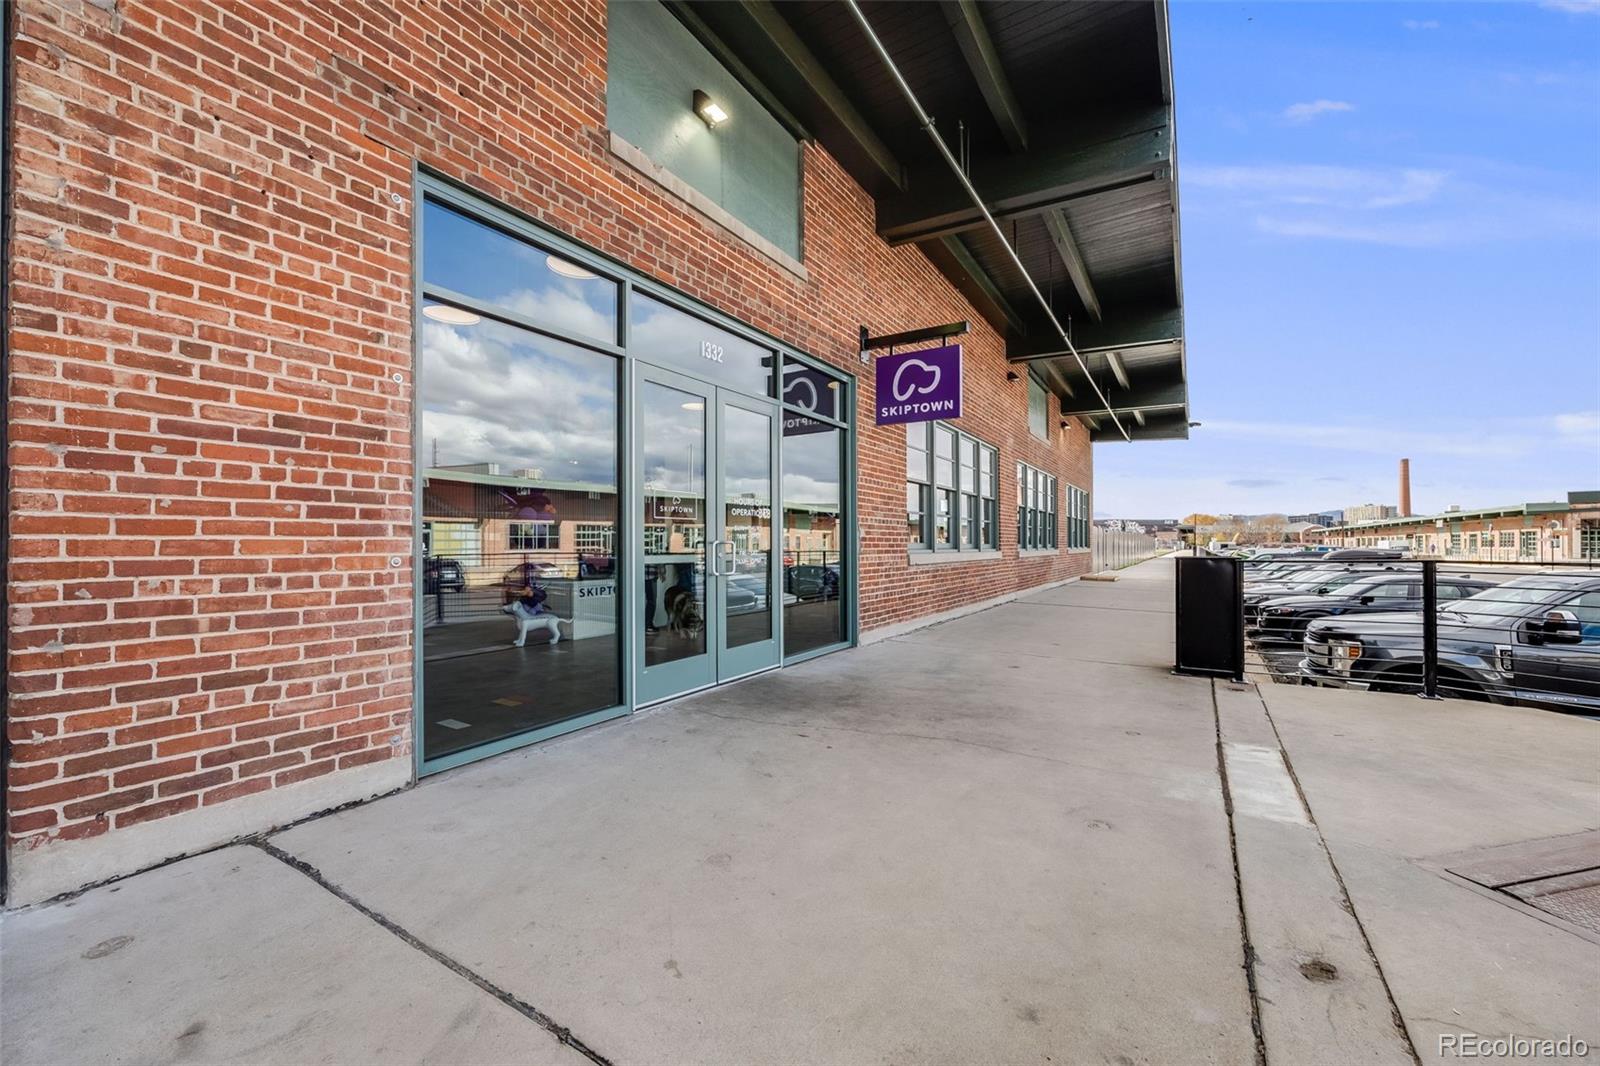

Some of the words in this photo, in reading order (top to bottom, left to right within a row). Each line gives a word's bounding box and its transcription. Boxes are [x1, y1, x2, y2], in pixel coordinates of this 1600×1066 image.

[702, 341, 723, 363] 1332
[881, 399, 954, 417] SKIPTOWN
[659, 505, 693, 513] SKIPTOWN
